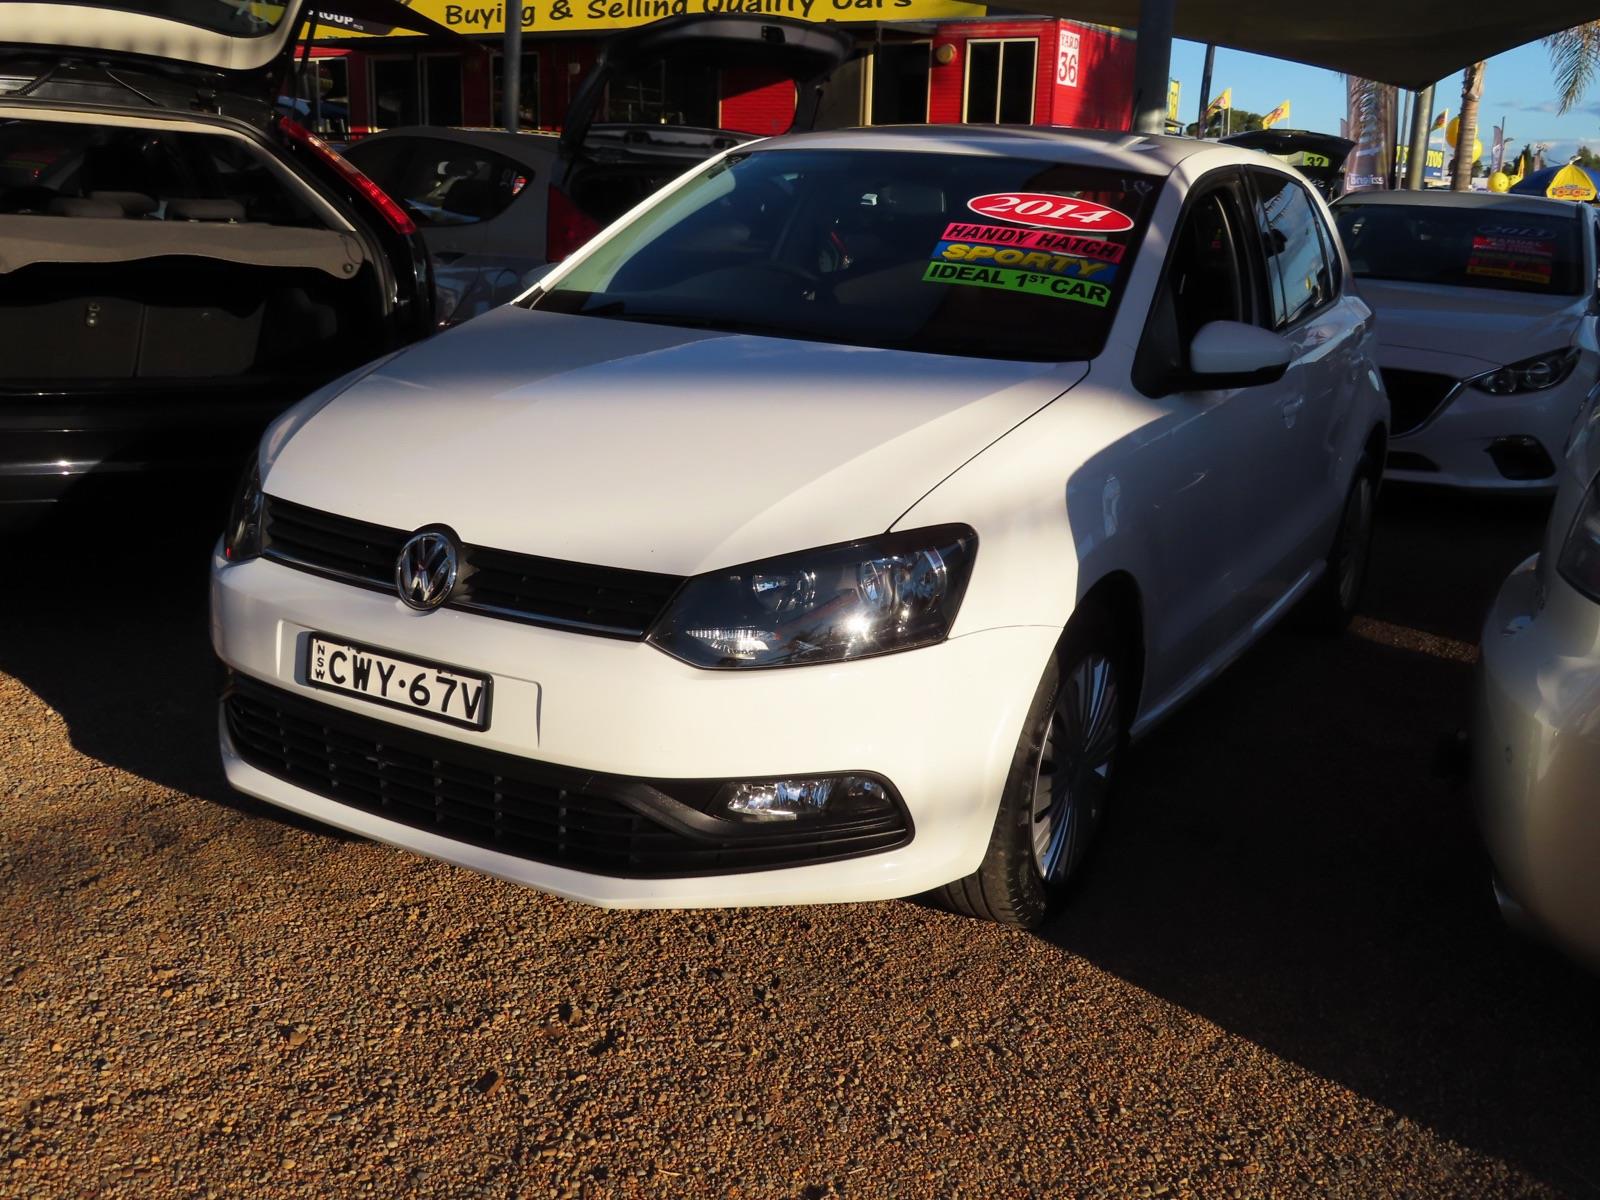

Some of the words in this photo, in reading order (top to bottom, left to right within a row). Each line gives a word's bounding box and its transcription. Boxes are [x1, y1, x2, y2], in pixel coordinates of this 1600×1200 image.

[445, 5, 536, 29] Buyig
[550, 0, 573, 20] &
[1059, 52, 1077, 83] 36
[979, 196, 1112, 223] 2014
[945, 225, 1033, 244] HANDY
[1036, 236, 1121, 257] HATCH
[942, 244, 1107, 278] SPORTY
[929, 264, 1005, 285] IDEAL
[1014, 273, 1049, 288] 1ST
[1051, 279, 1109, 303] CAR
[315, 644, 325, 680] NSW
